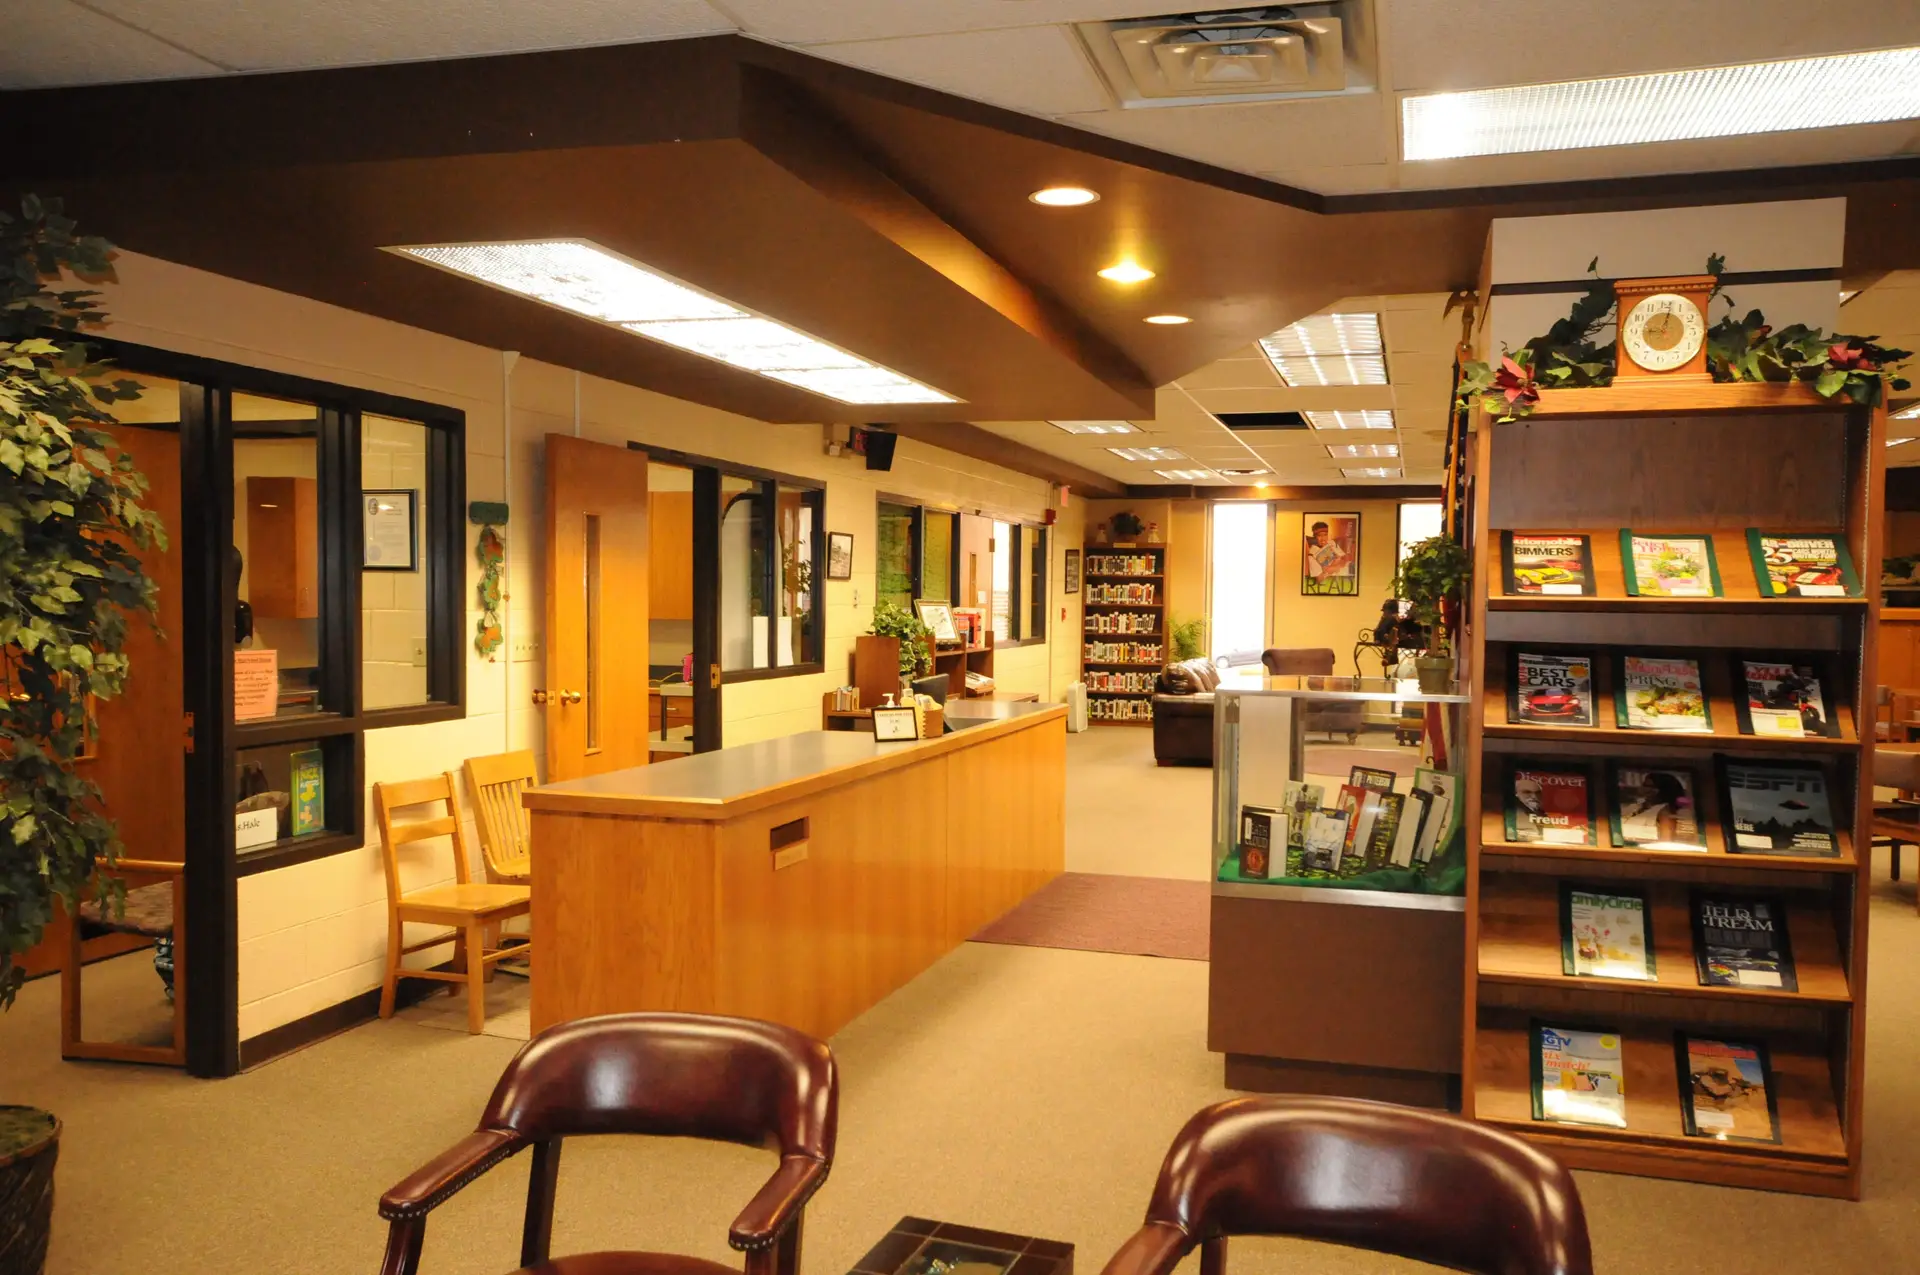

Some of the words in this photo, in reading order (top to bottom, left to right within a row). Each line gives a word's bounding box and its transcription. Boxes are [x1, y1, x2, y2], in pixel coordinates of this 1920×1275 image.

[1515, 547, 1573, 556] BIMMERS
[1762, 547, 1793, 565] 25
[1305, 576, 1354, 594] READ
[1528, 667, 1568, 678] BEST
[1528, 677, 1576, 687] CARS
[1727, 770, 1822, 793] ESPN
[1529, 814, 1569, 824] Freud
[1571, 894, 1643, 911] amilyCircle
[1704, 905, 1750, 919] IELD
